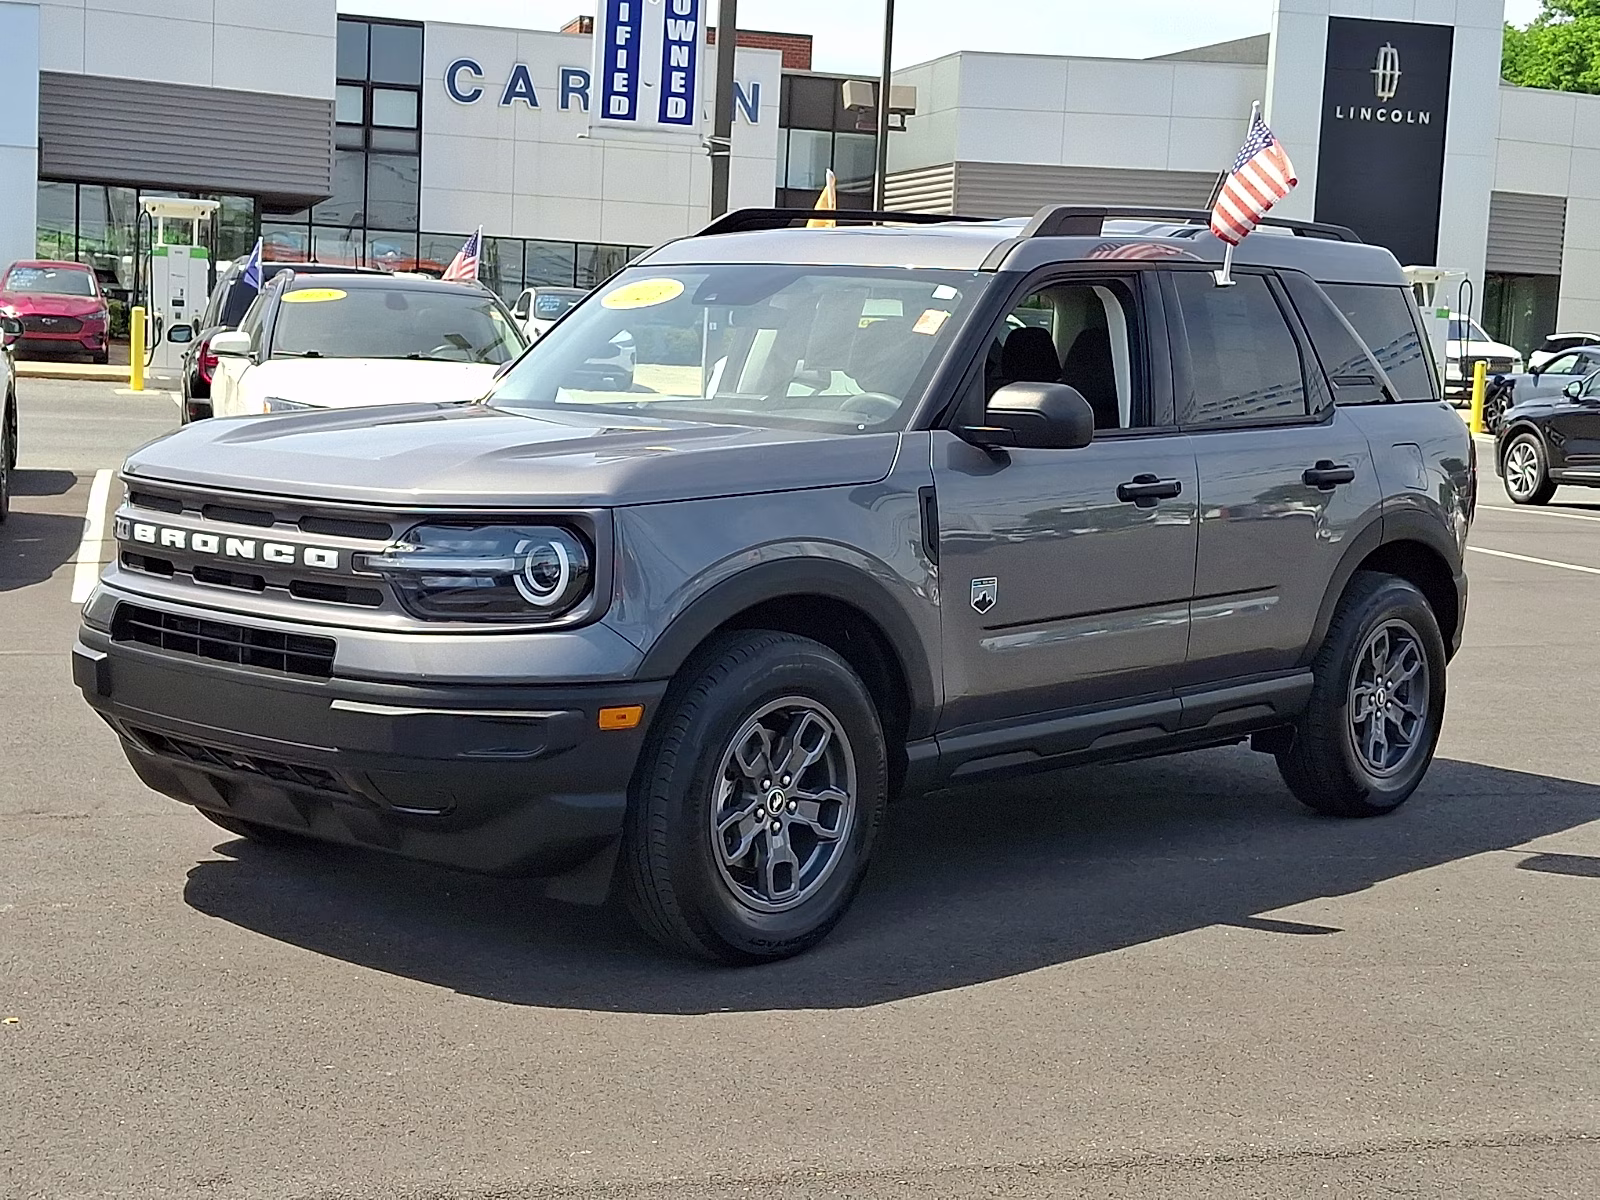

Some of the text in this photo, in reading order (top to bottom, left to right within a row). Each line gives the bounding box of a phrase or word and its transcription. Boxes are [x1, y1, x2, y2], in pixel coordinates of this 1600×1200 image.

[444, 57, 761, 126] CARN
[1335, 105, 1430, 125] LINCOLN
[133, 522, 339, 569] BRONCO
